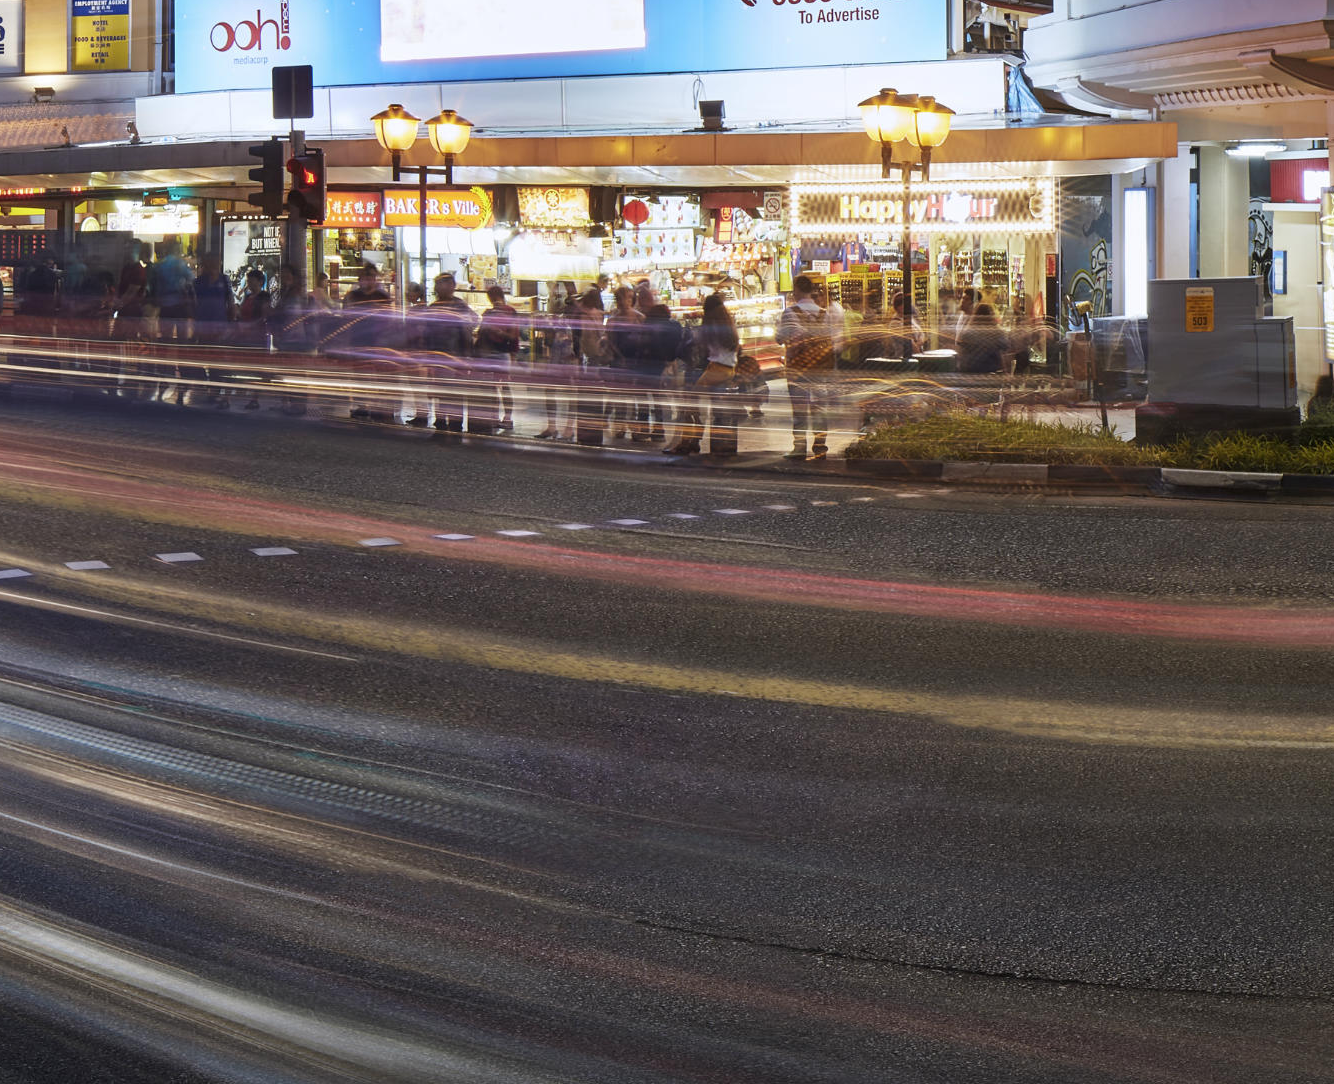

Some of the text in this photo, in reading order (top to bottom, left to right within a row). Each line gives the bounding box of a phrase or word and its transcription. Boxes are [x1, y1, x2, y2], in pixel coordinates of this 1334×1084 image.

[798, 7, 880, 24] To Advertise
[233, 56, 269, 65] mediacorp
[452, 199, 480, 215] Ville
[264, 226, 275, 238] NOT
[251, 238, 263, 250] BUT
